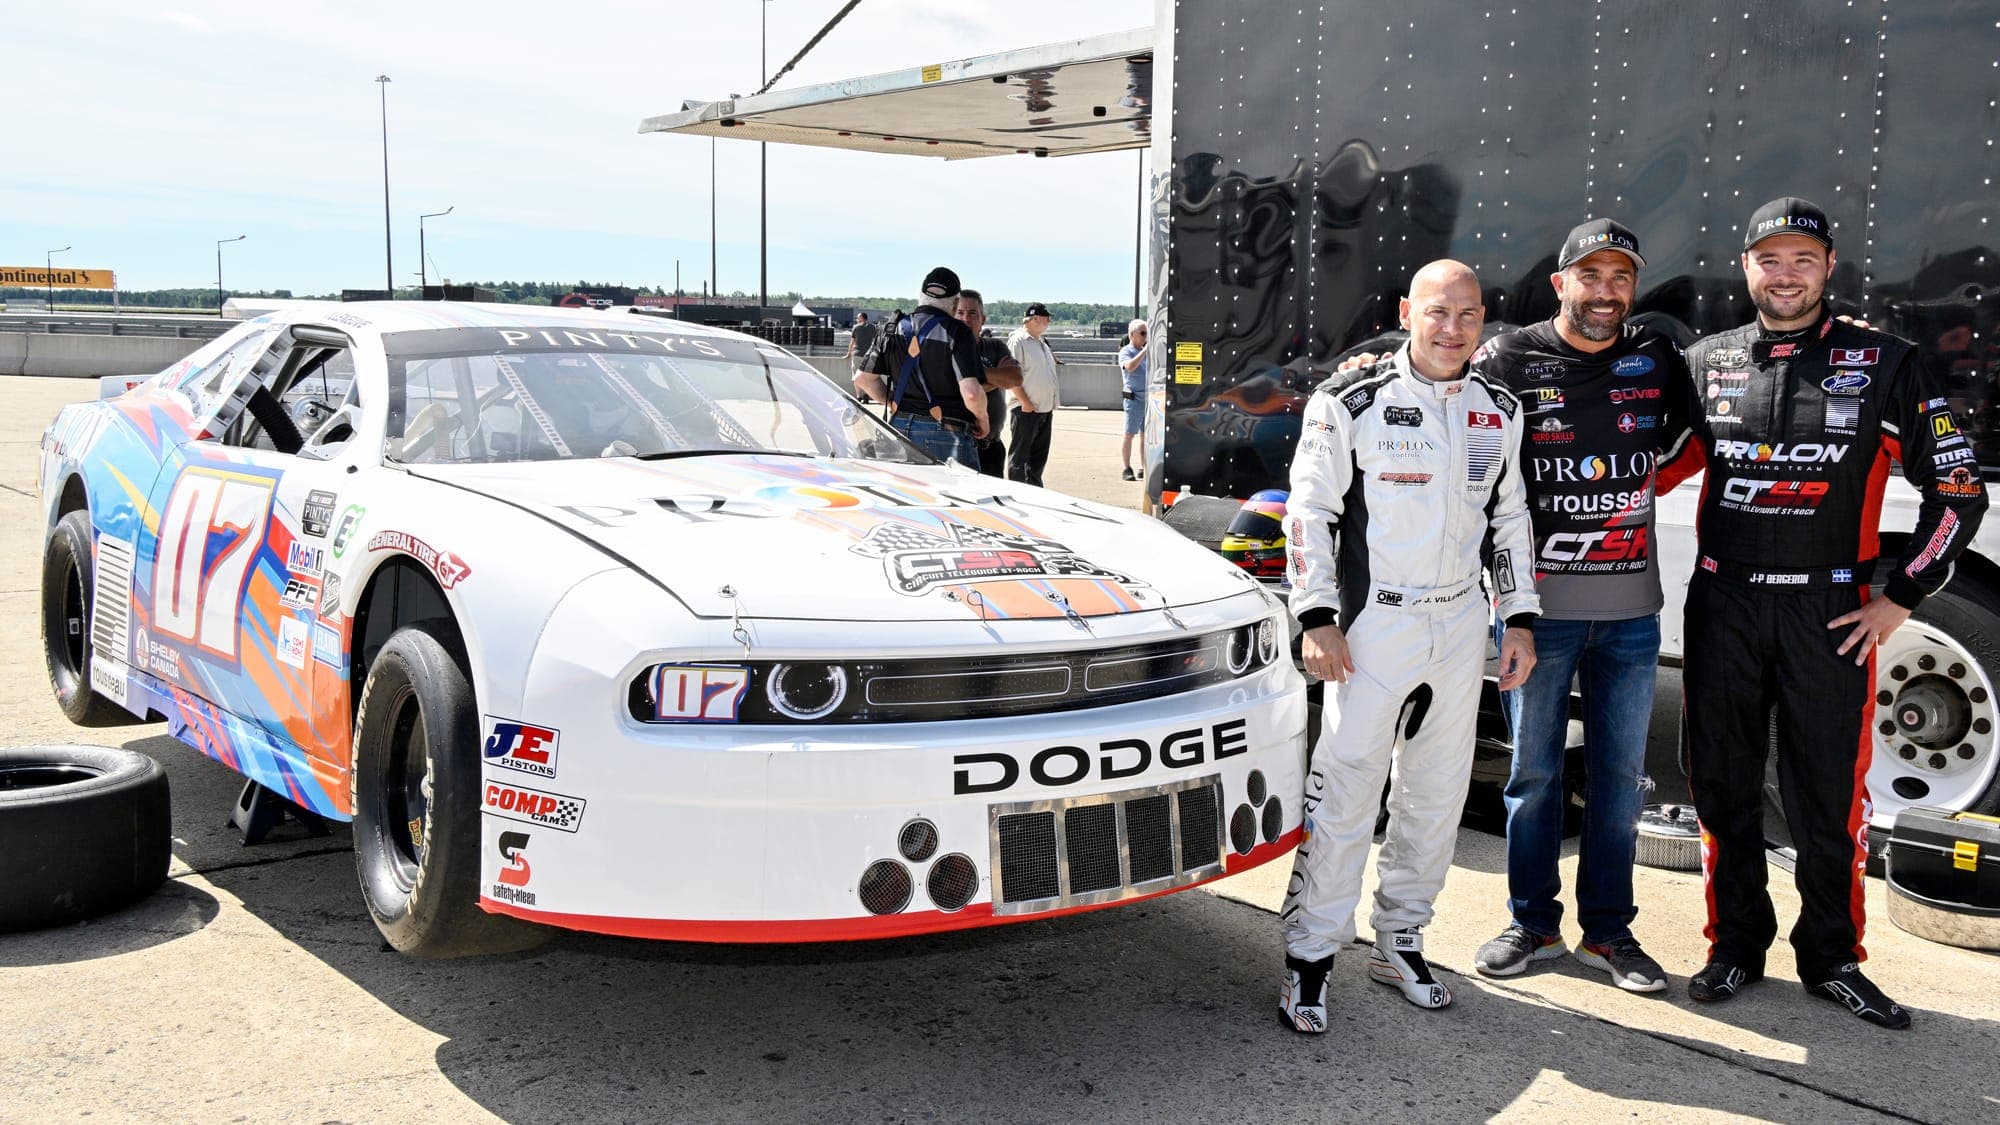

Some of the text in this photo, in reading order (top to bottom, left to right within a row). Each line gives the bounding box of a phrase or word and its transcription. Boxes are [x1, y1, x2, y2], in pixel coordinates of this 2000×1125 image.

[1758, 216, 1818, 233] PROLON
[1579, 232, 1634, 250] PROLON
[0, 269, 76, 284] ntinental
[498, 329, 726, 359] PINTY'S
[1525, 365, 1566, 375] PINTY'S
[1347, 391, 1369, 409] OMP
[1540, 388, 1559, 401] DL
[1386, 410, 1421, 421] PINTY'S
[1935, 416, 1956, 435] DL
[1551, 431, 1576, 441] SKILLS
[1378, 440, 1434, 453] PROLON
[1714, 440, 1849, 462] PROLON
[1936, 483, 1960, 494] AERO
[304, 504, 333, 522] PINTY'S
[290, 542, 316, 569] Mobil
[369, 532, 438, 569] GENERAL TIRE
[154, 470, 275, 663] 07
[1535, 560, 1567, 571] CIRCUIT
[905, 571, 945, 591] CIRCUIT
[1001, 566, 1041, 575] ST-ROCH
[1750, 573, 1810, 584] J-P BERGERON
[284, 580, 318, 604] PFC
[1377, 592, 1403, 604] OMP
[1435, 584, 1475, 604] VILLENEU
[150, 641, 180, 664] SHELBY
[150, 656, 180, 680] CANADA
[93, 667, 125, 697] rousseau
[660, 667, 748, 720] 07
[484, 722, 555, 765] JE
[954, 718, 1248, 795] DODGE
[501, 757, 554, 777] PISTONS
[485, 785, 557, 816] COMP
[531, 812, 570, 827] CAMS
[1395, 938, 1414, 946] OMP
[1302, 1010, 1323, 1028] OMP
